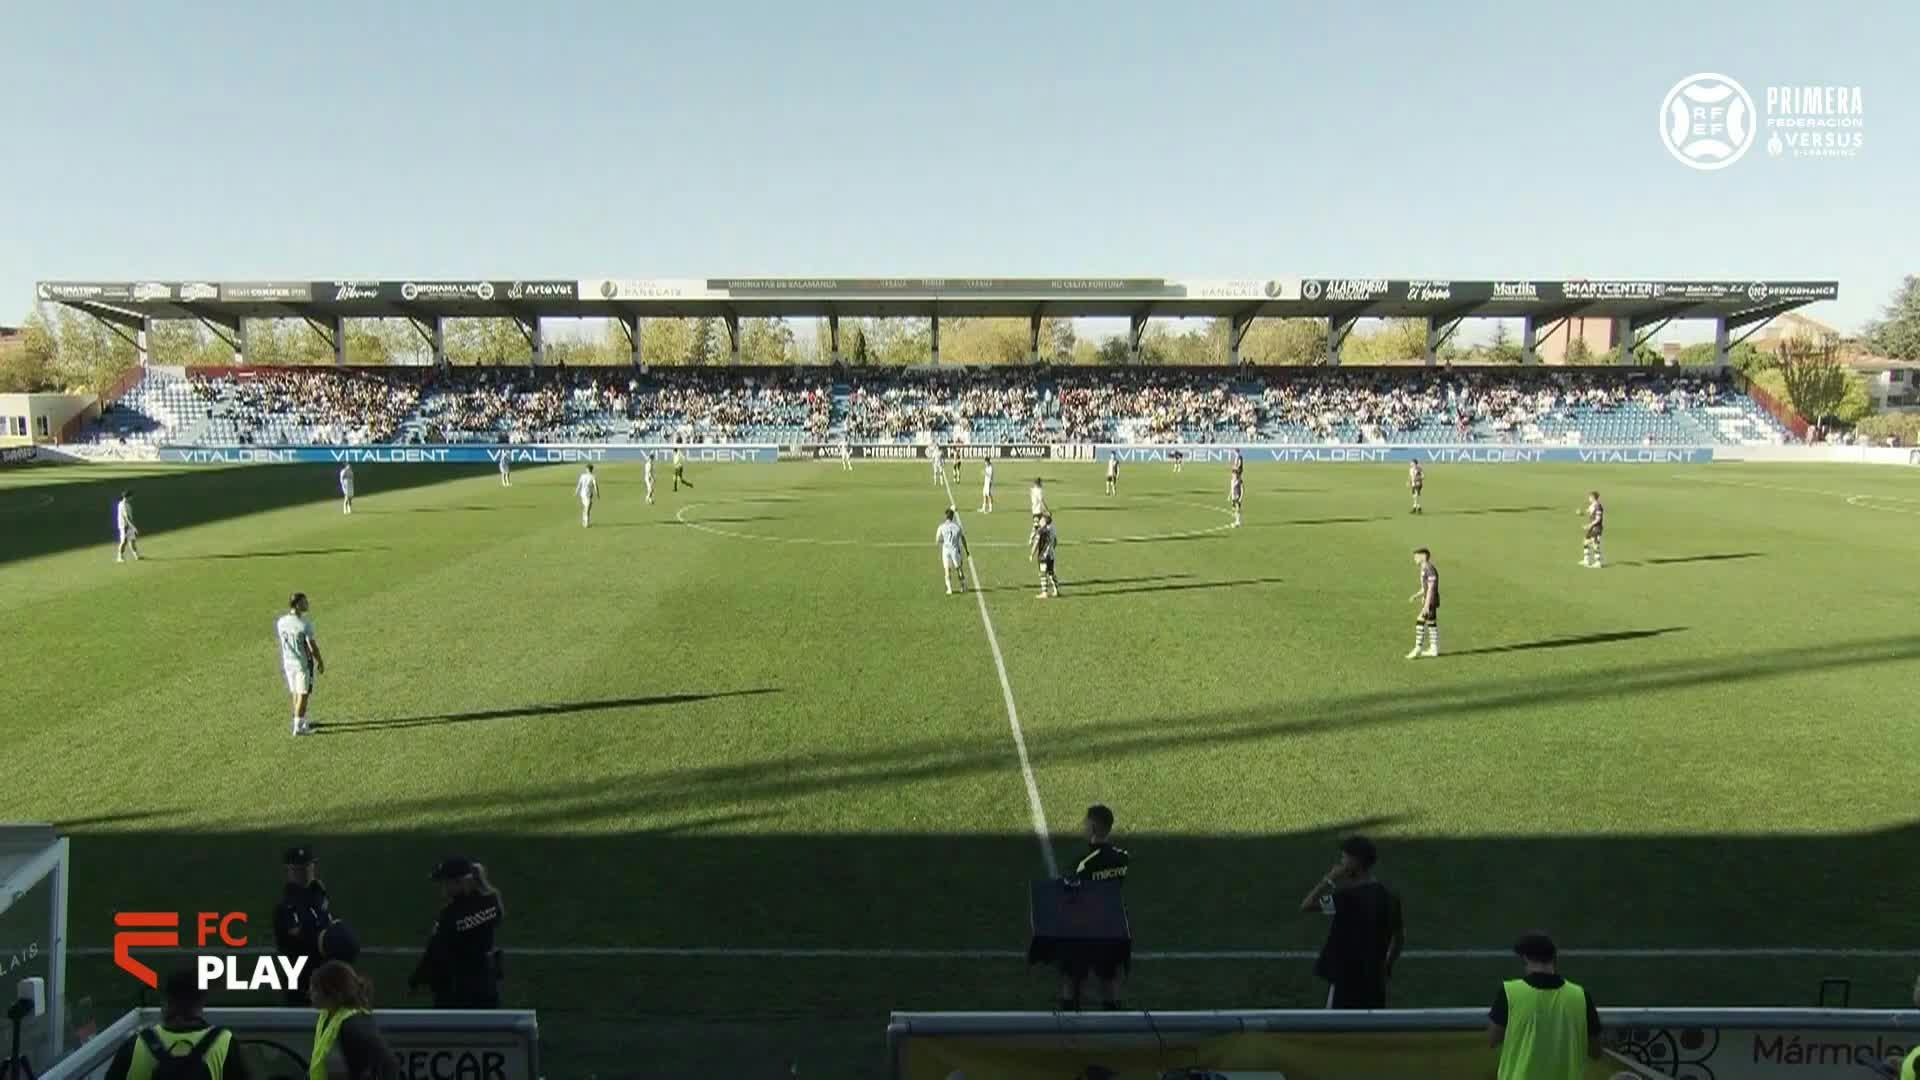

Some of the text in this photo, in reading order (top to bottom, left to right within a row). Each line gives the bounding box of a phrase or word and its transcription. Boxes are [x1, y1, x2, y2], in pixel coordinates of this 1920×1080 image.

[1562, 282, 1653, 294] SMARTCENTER
[1768, 286, 1835, 295] PERFORMANCE
[179, 449, 297, 463] VITALDENT
[330, 449, 449, 462] VITALDENT
[1271, 449, 1390, 462] VITALDENT
[1427, 449, 1545, 462] VITALDENT
[1579, 449, 1696, 462] VITALDENT
